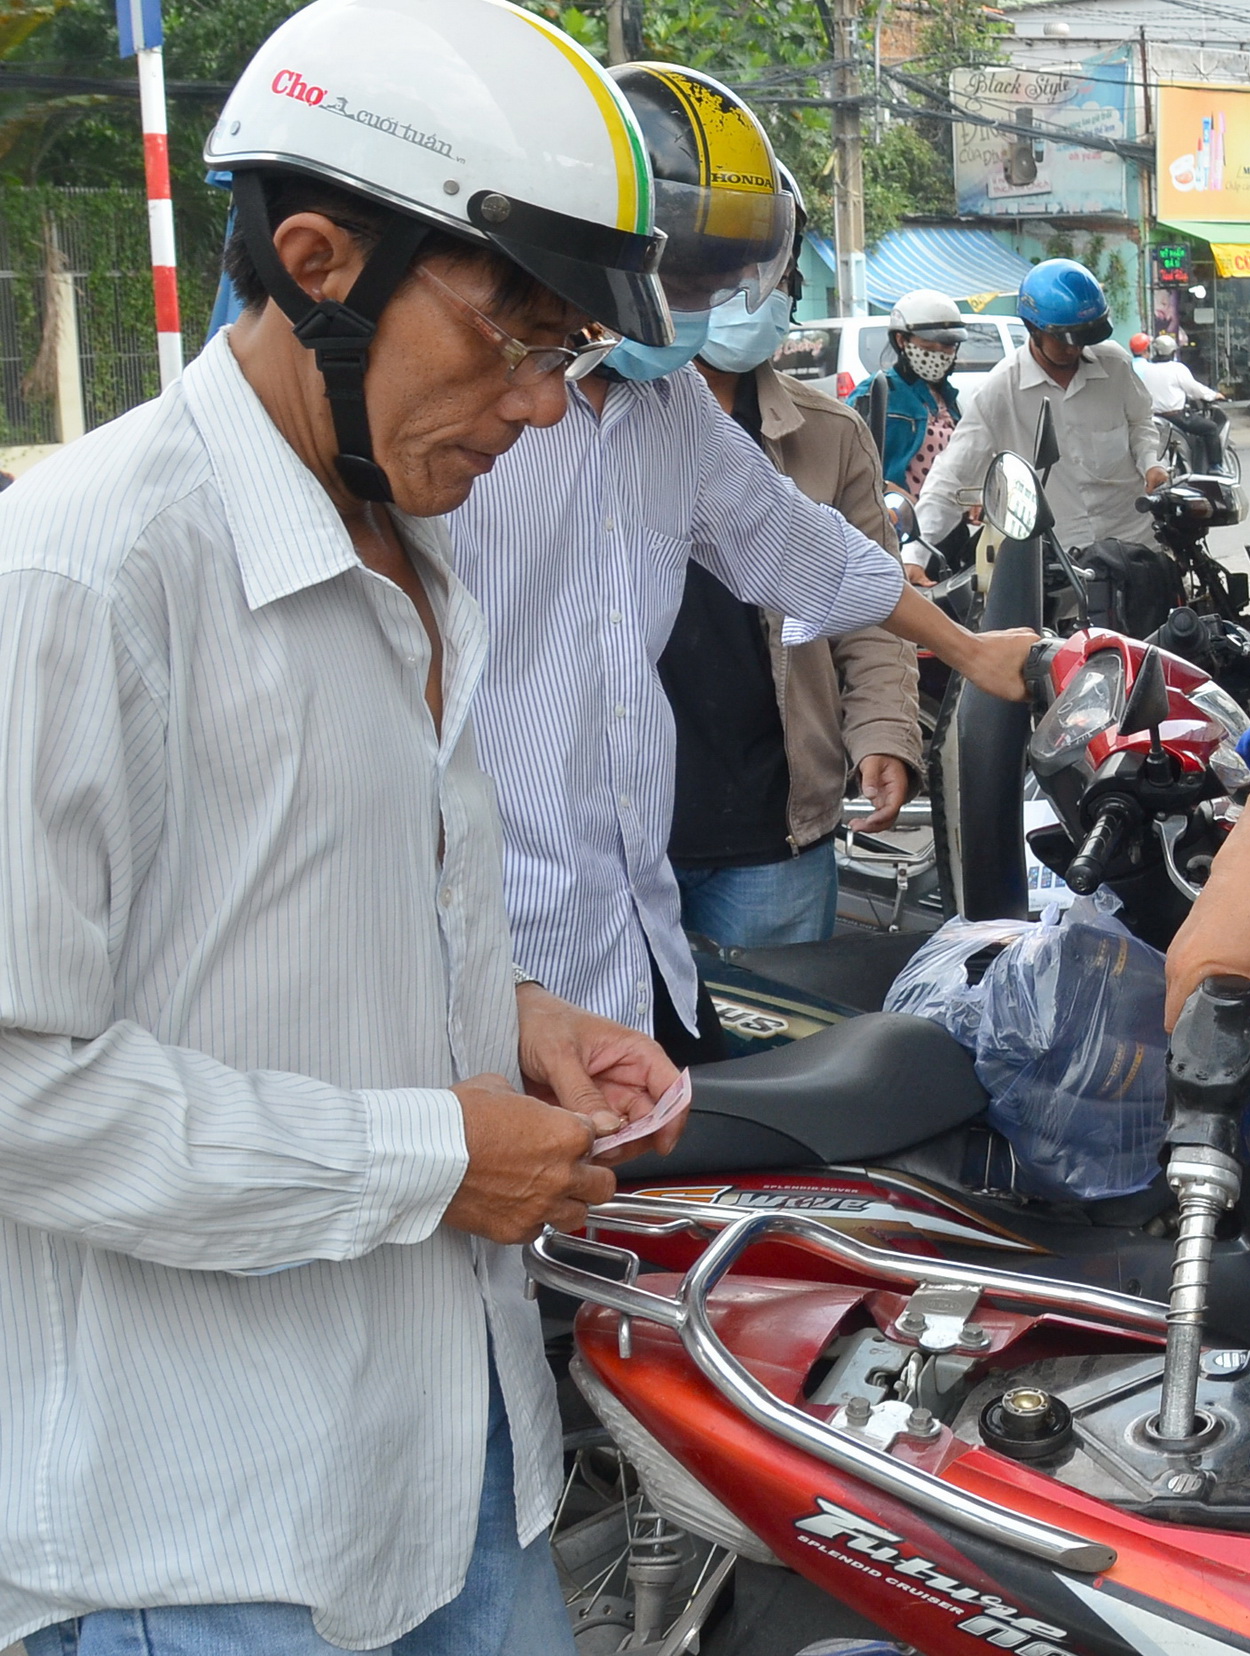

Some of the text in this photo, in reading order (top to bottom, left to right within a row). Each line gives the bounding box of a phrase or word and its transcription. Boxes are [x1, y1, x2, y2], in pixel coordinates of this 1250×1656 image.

[271, 69, 328, 107] Chợ
[965, 72, 1070, 102] Black Style
[356, 108, 399, 136] cuối
[711, 173, 773, 189] HONDA
[796, 1534, 965, 1616] SPLENDID CRUISER
